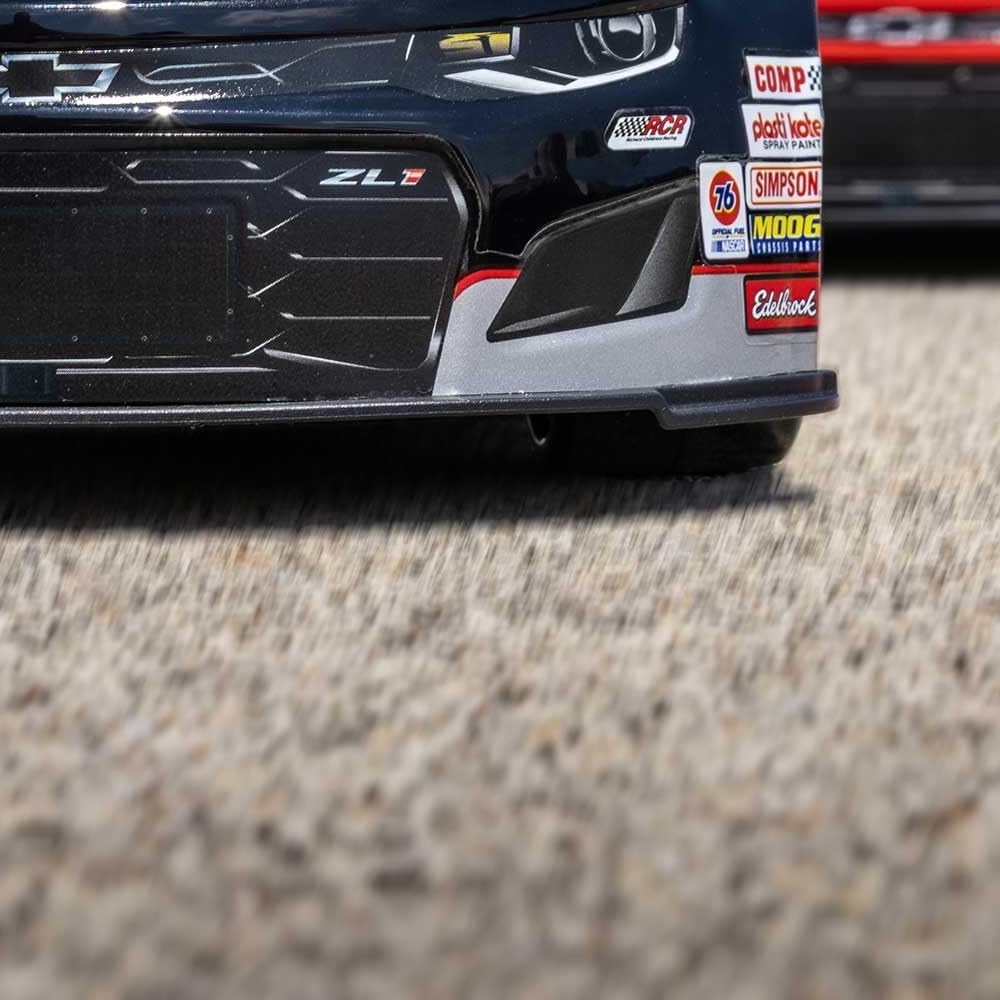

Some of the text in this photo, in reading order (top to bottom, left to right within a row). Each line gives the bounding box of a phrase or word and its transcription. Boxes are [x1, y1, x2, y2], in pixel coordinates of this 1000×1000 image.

[754, 65, 806, 93] COMP
[642, 115, 688, 135] RCR
[752, 112, 822, 142] plasti kote
[763, 139, 821, 149] SPRAY PAINT
[319, 168, 426, 186] ZL1
[713, 180, 737, 213] 76
[753, 214, 821, 239] MOOG
[757, 241, 789, 254] CHASSIS
[752, 288, 817, 320] Edelbrock
